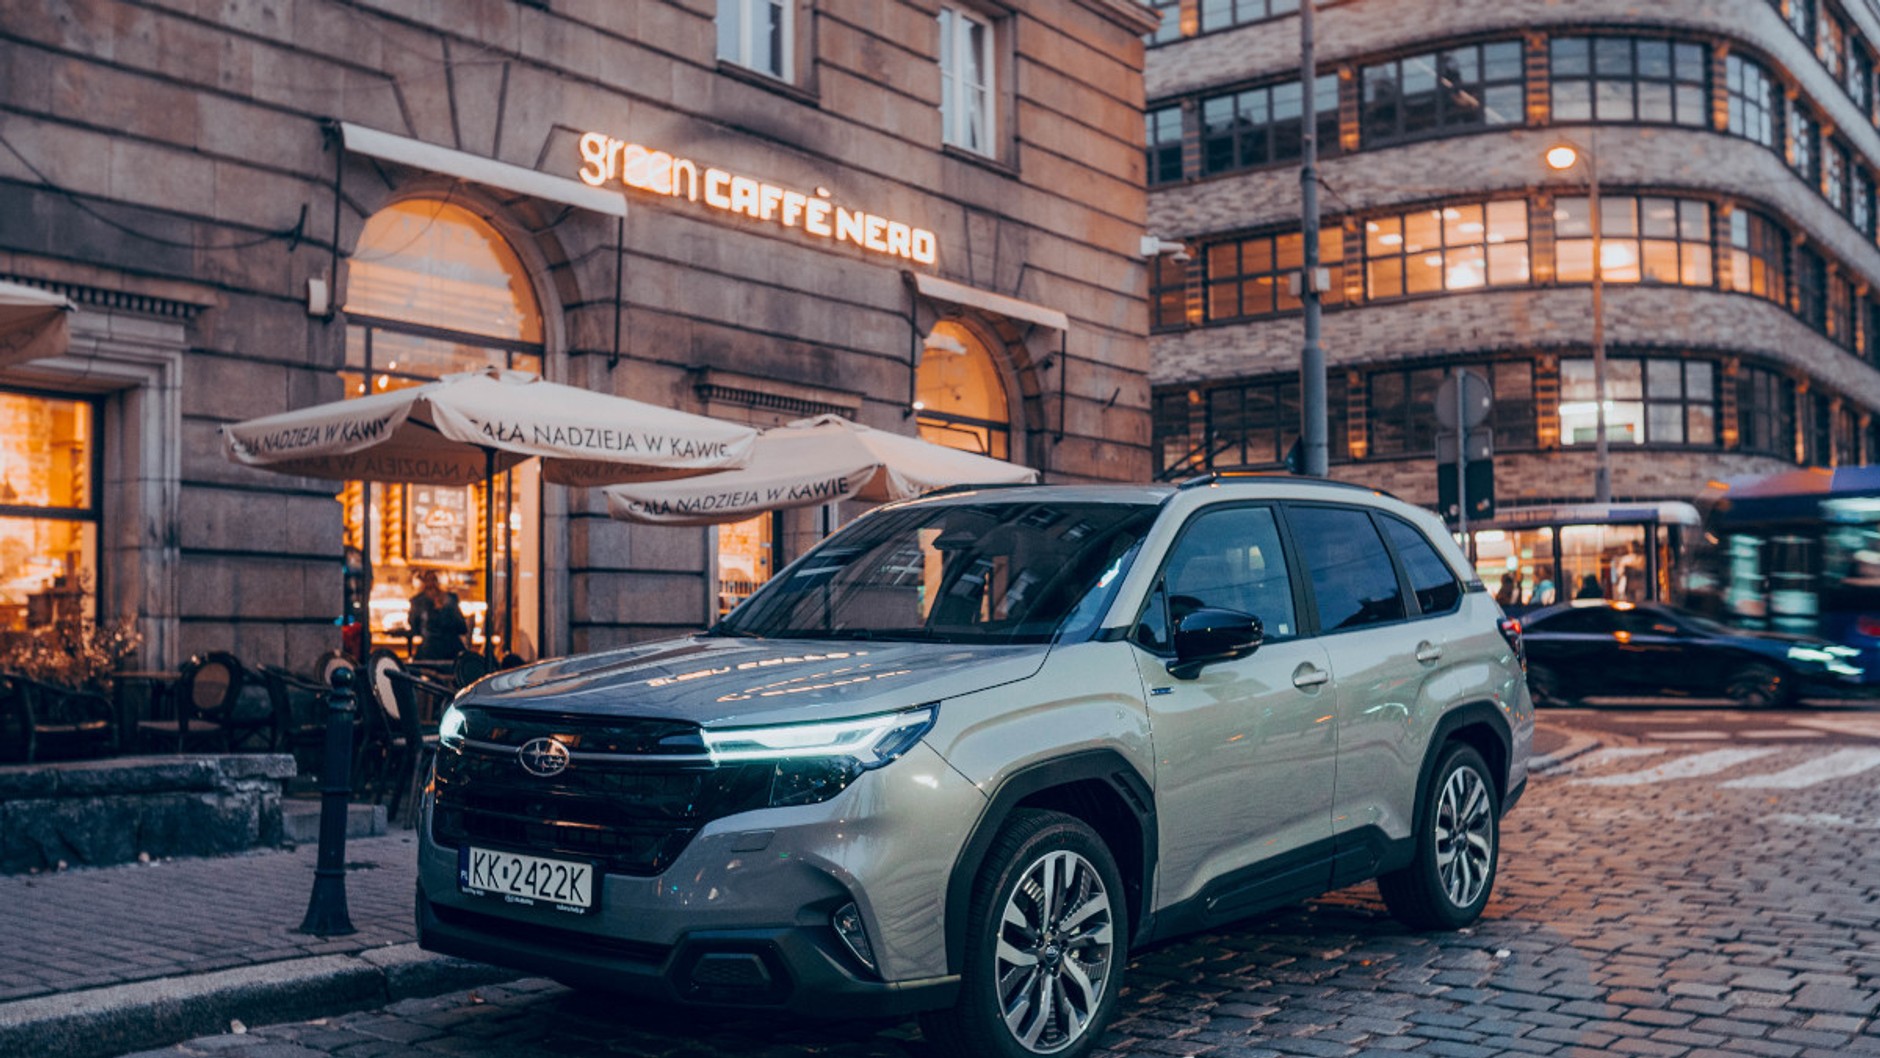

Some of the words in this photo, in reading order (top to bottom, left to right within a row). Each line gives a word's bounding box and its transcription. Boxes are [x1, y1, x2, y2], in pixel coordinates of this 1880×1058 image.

[836, 206, 936, 264] NERO
[265, 426, 319, 451] NADZIEJA
[326, 424, 339, 442] W
[469, 419, 525, 444] AŁA
[534, 425, 638, 452] NADZIEJA
[644, 434, 662, 452] W
[676, 492, 759, 513] NADZIEJA
[768, 488, 784, 500] W
[788, 477, 848, 501] KAWIE
[473, 851, 500, 889] KK
[510, 858, 585, 903] 2422K
